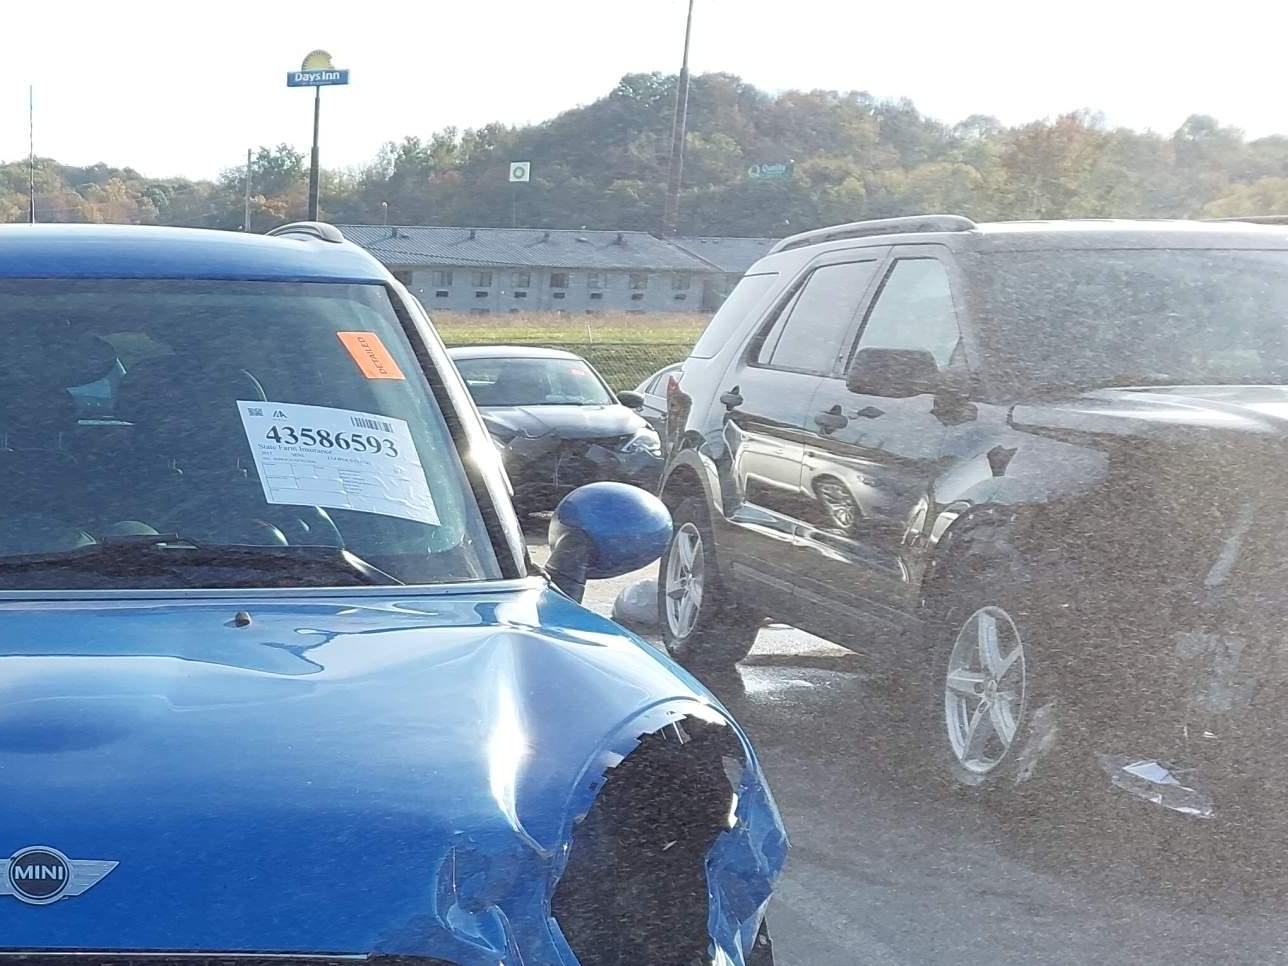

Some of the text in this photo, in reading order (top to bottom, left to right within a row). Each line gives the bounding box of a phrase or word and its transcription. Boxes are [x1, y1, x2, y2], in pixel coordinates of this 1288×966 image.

[295, 71, 340, 82] Days Inn
[356, 336, 388, 375] DETAILED
[265, 424, 399, 458] 43586593
[14, 865, 63, 881] MINI
